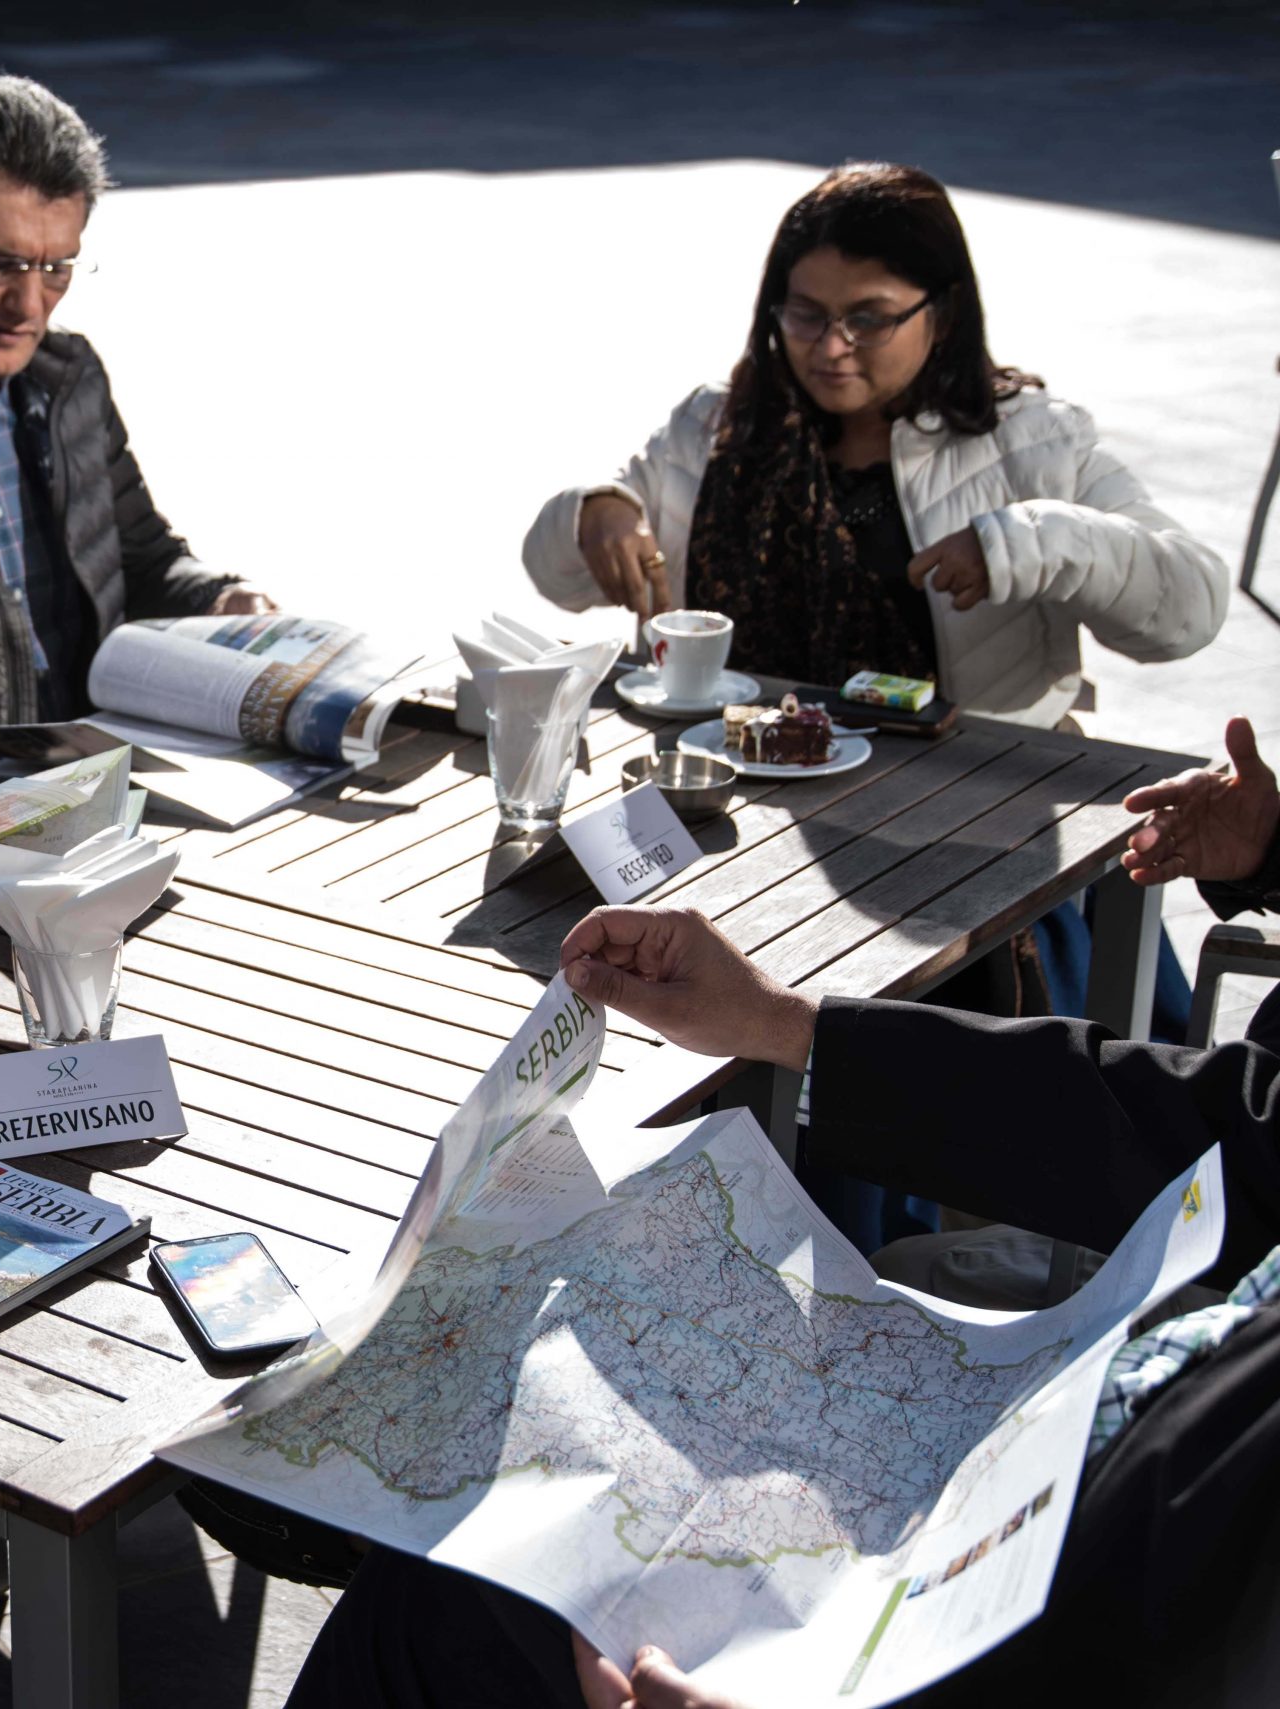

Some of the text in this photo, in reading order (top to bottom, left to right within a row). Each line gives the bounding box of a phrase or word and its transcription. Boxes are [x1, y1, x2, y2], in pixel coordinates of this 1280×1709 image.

[617, 843, 674, 886] RESERVED
[516, 992, 596, 1086] SERBIA
[3, 1173, 63, 1199] travel
